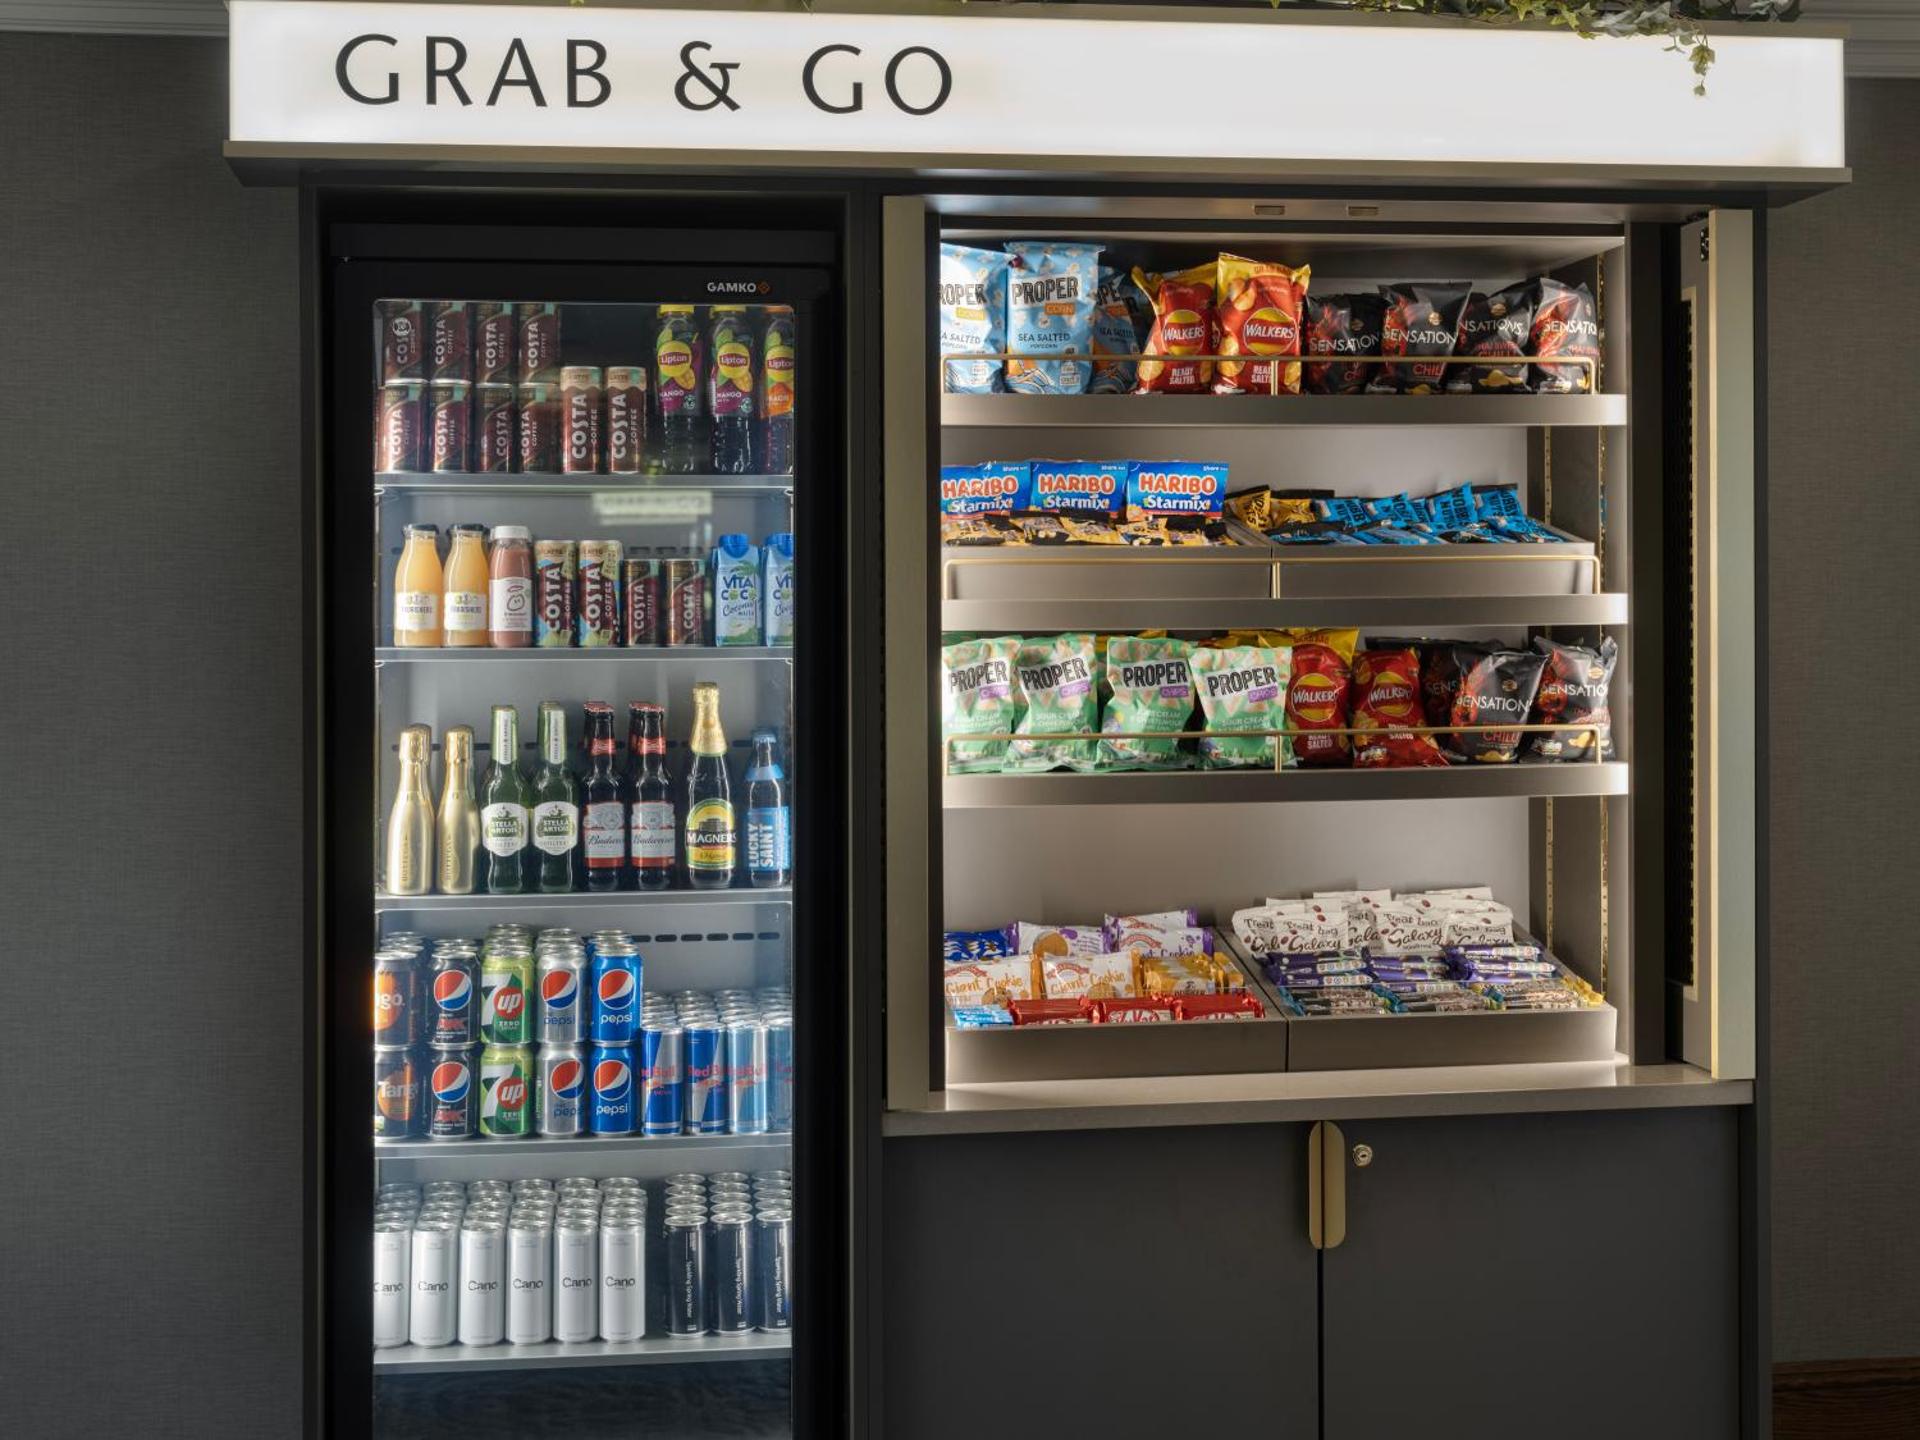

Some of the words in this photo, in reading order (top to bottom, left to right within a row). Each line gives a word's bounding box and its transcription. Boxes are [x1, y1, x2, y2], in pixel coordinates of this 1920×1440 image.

[336, 33, 612, 108] GRAB
[674, 40, 741, 113] &
[802, 44, 952, 116] GO
[707, 282, 756, 293] GAMKO
[940, 283, 987, 305] ROPER
[1012, 276, 1078, 305] PROPER
[1163, 326, 1204, 341] WALKERS
[1245, 323, 1295, 339] WALKERS
[1383, 325, 1457, 344] SENSATION
[1459, 318, 1523, 336] NSATIONS
[434, 319, 447, 365] COSTA
[485, 322, 498, 369] COSTA
[527, 322, 539, 369] COSTA
[1018, 332, 1035, 342] SEA
[1037, 332, 1072, 342] SALTED
[661, 353, 688, 365] Lipton
[720, 355, 747, 367] Lipton
[768, 357, 793, 369] Lipto
[436, 409, 448, 456] COSTA
[521, 410, 532, 457] COSTA
[571, 393, 588, 459] COSTA
[612, 393, 628, 459] COSTA
[942, 475, 1019, 499] HARIBO
[1038, 473, 1116, 495] HARIBO
[1139, 472, 1217, 495] HARIBO
[951, 495, 1010, 513] Starmix
[1045, 494, 1107, 511] Starmix
[1147, 494, 1208, 511] Starmix
[723, 574, 754, 589] VITA
[546, 567, 562, 632] COSTA
[586, 567, 602, 632] COSTA
[634, 584, 645, 630] COSTA
[683, 584, 695, 630] COSTA
[949, 660, 1008, 693] PROPER
[1021, 657, 1088, 690] PROPER
[1123, 661, 1188, 687] PROPER
[1207, 666, 1277, 696] PROPER
[543, 819, 569, 827] STELLA
[686, 831, 737, 844] MAGNERS
[748, 823, 760, 868] LUCKY
[759, 823, 774, 868] SAINT
[1244, 918, 1274, 929] Treat
[1384, 913, 1413, 925] Treat
[1288, 935, 1342, 952] Galaxy
[1348, 927, 1380, 946] Gala
[1388, 926, 1444, 948] Galaxy
[544, 1014, 576, 1025] pepsi
[600, 1011, 633, 1025] pepsi
[596, 1102, 628, 1116] pepsi
[418, 1280, 449, 1292] Cano
[468, 1280, 498, 1292] Cano
[513, 1277, 544, 1290] Cano
[562, 1276, 593, 1289] Cano
[605, 1275, 636, 1288] Cano
